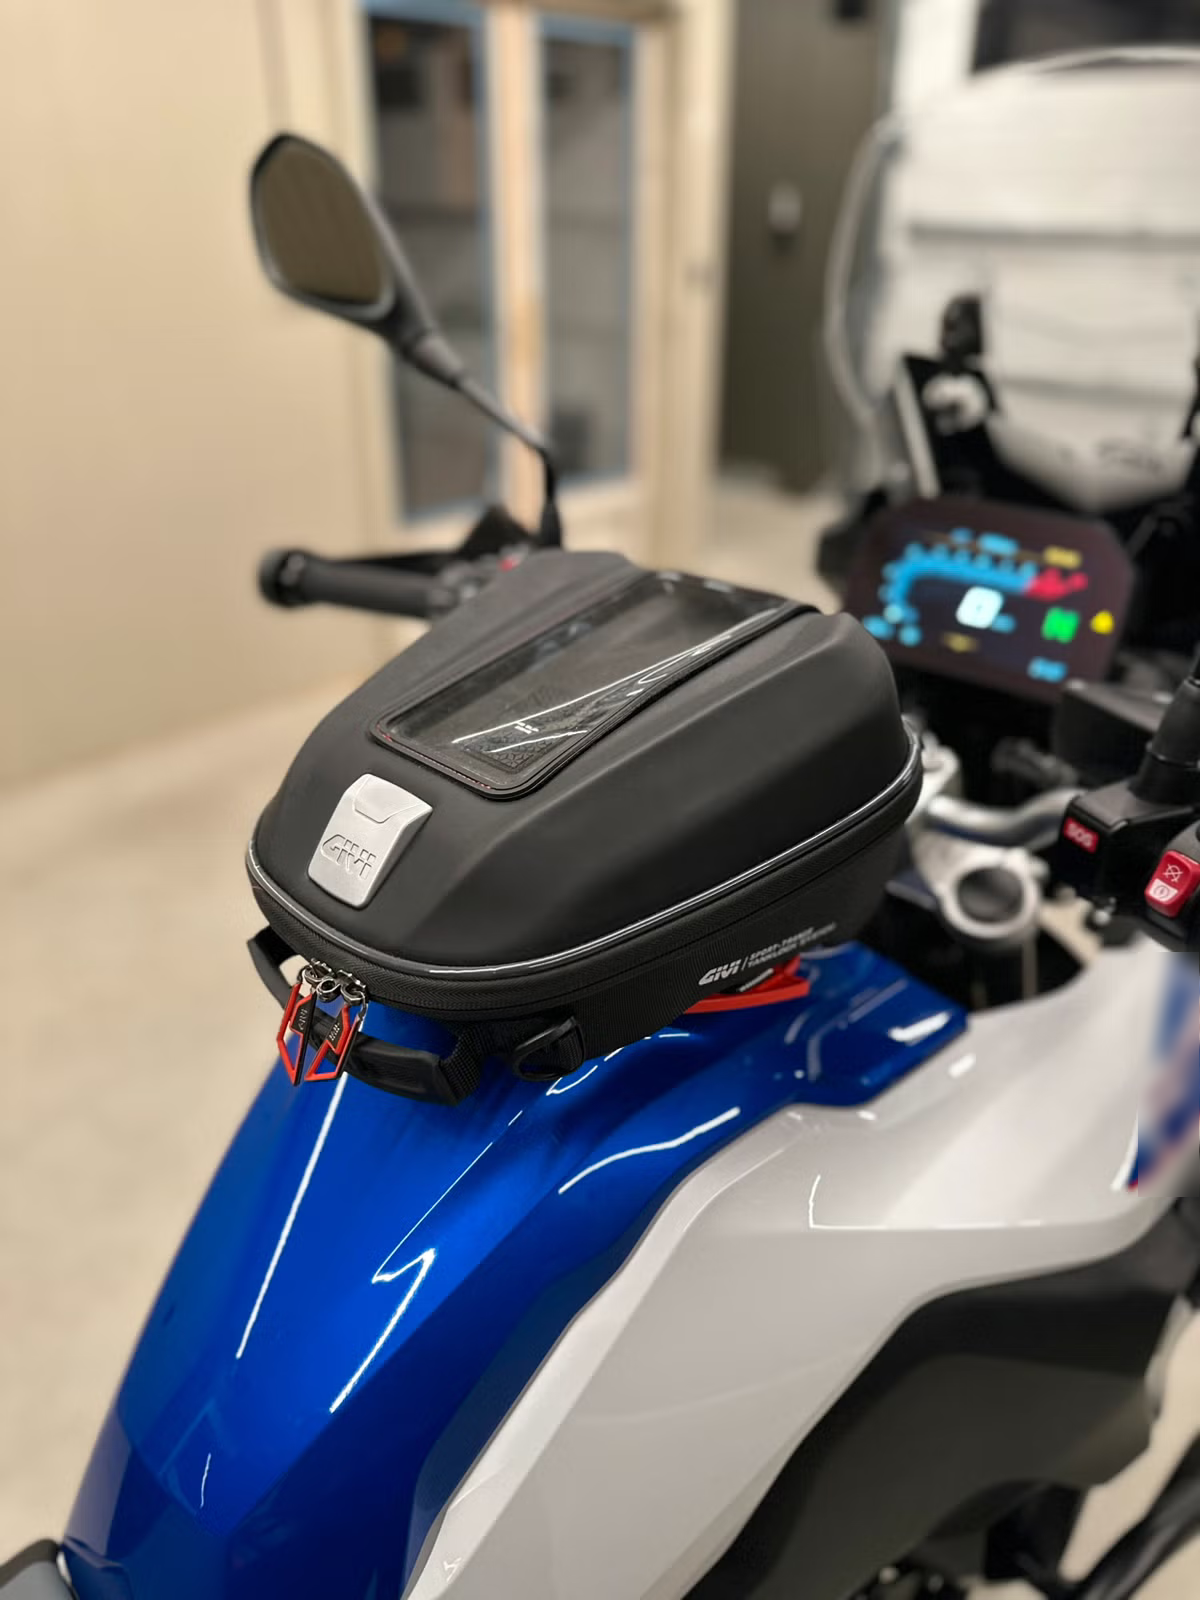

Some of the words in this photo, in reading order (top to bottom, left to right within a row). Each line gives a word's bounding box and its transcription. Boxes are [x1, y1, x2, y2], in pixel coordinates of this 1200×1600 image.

[1067, 821, 1094, 849] SOS
[320, 833, 377, 881] GIVI
[698, 958, 742, 986] GIVI
